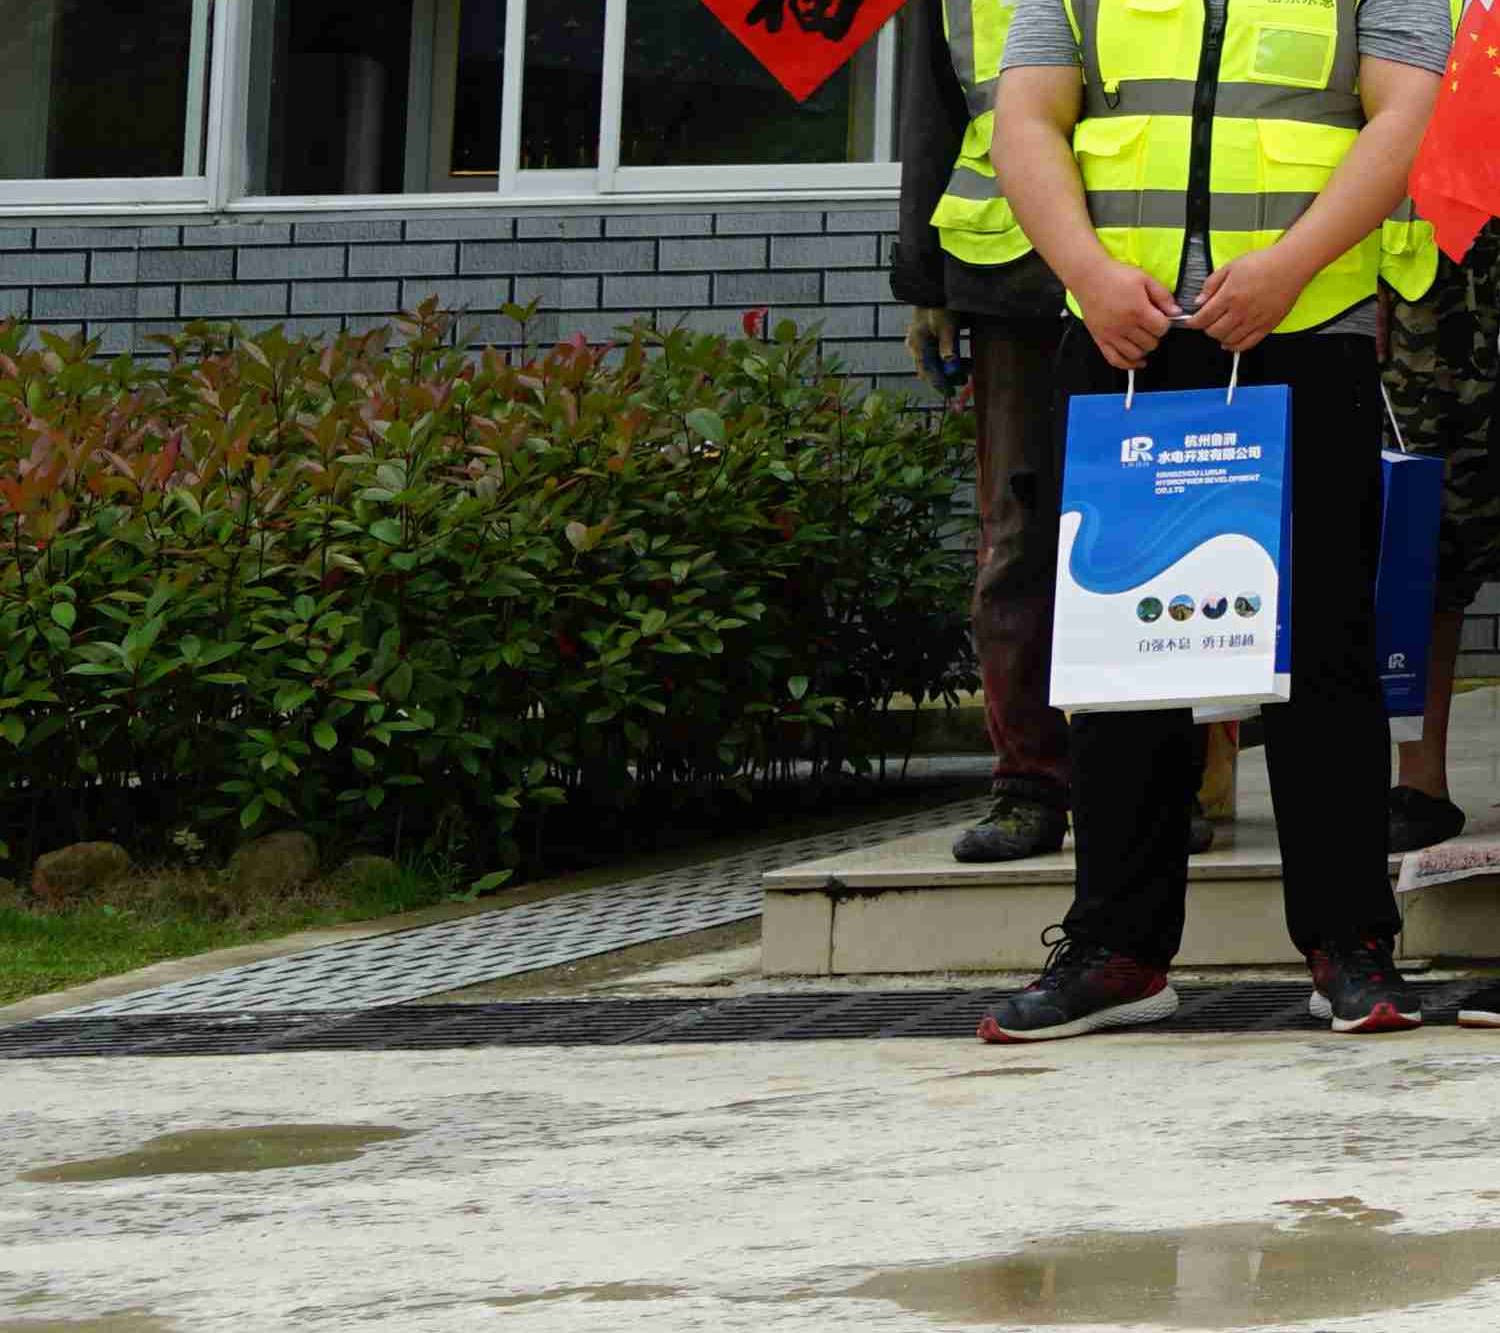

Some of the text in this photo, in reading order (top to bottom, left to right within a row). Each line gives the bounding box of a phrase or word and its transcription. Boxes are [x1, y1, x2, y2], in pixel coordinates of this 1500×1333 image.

[1137, 632, 1256, 653] 自强不息 勇于超越
